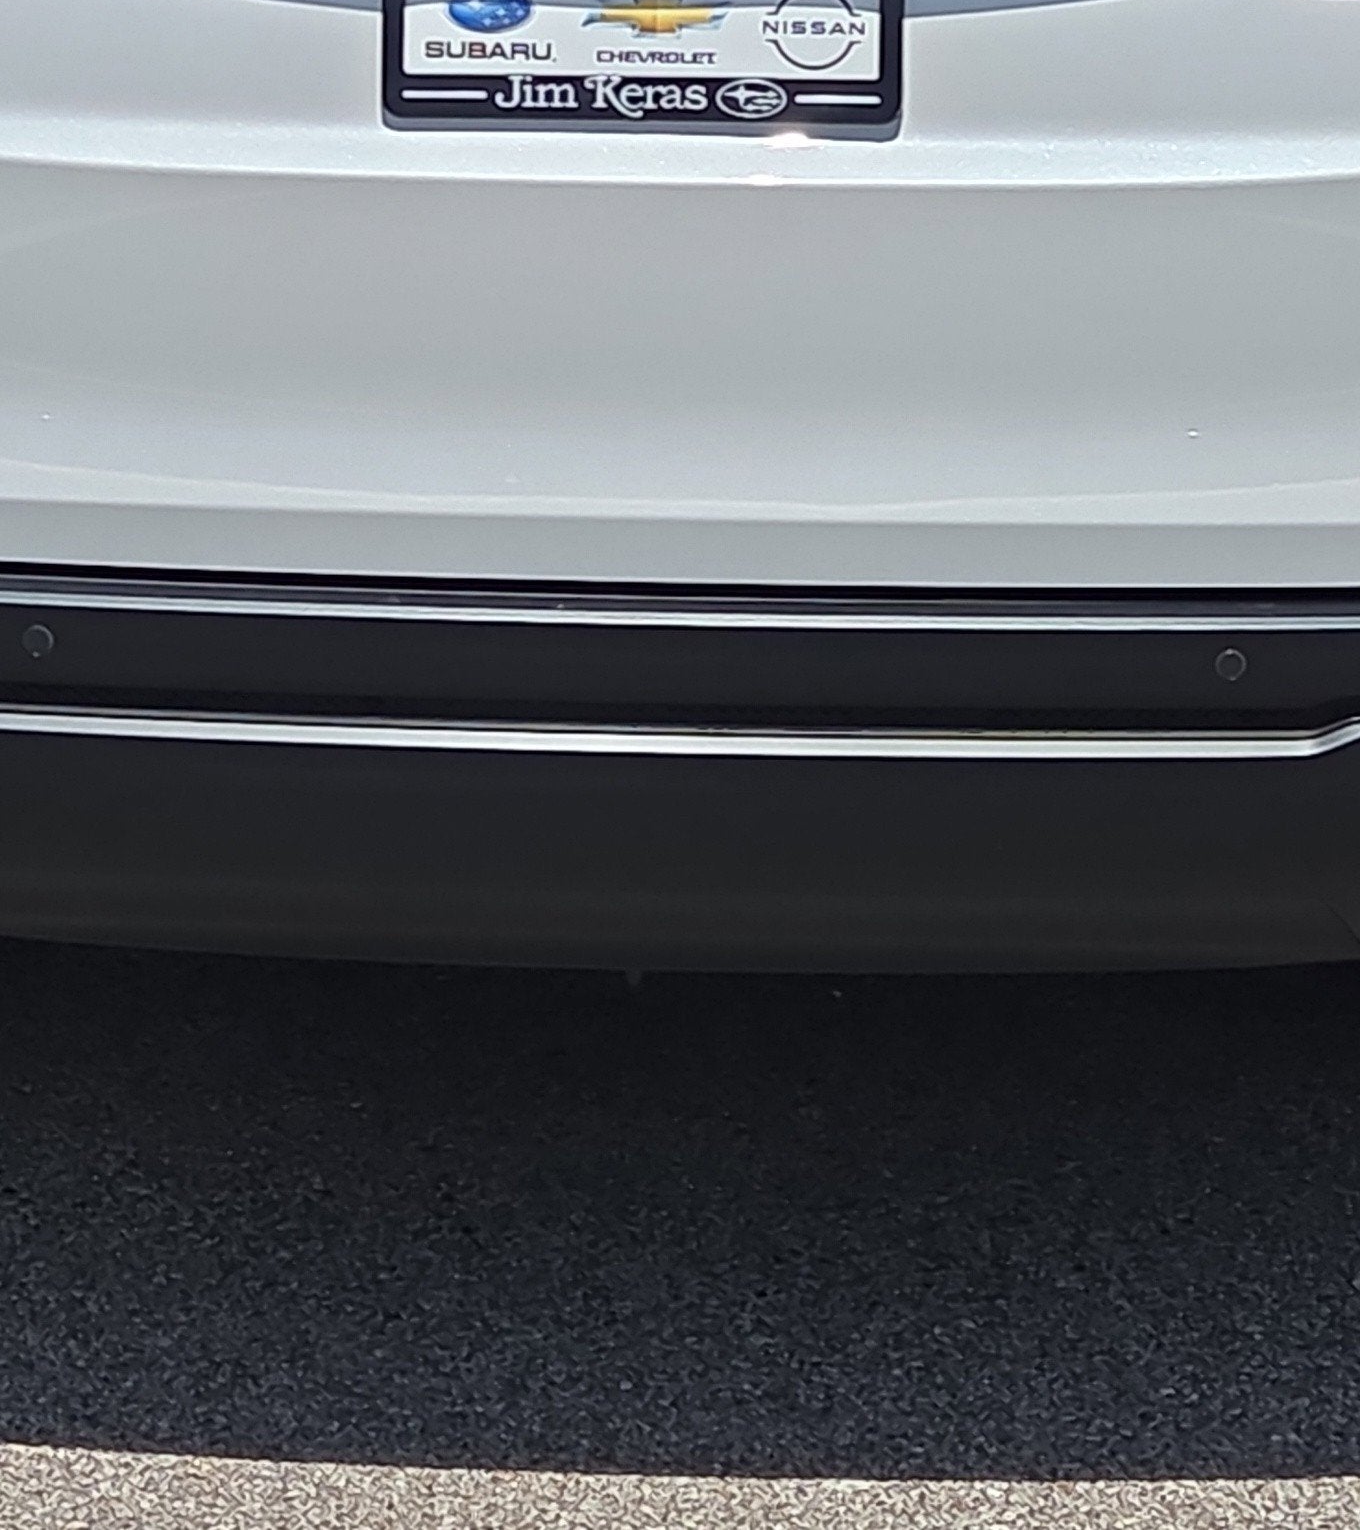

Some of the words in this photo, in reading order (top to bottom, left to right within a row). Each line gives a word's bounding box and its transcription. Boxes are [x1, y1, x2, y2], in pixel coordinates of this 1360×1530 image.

[761, 20, 866, 38] NISSAN
[424, 41, 552, 62] SUBARU
[595, 49, 717, 65] CHEVROLET
[494, 75, 580, 110] Jim
[583, 74, 707, 118] Keras
